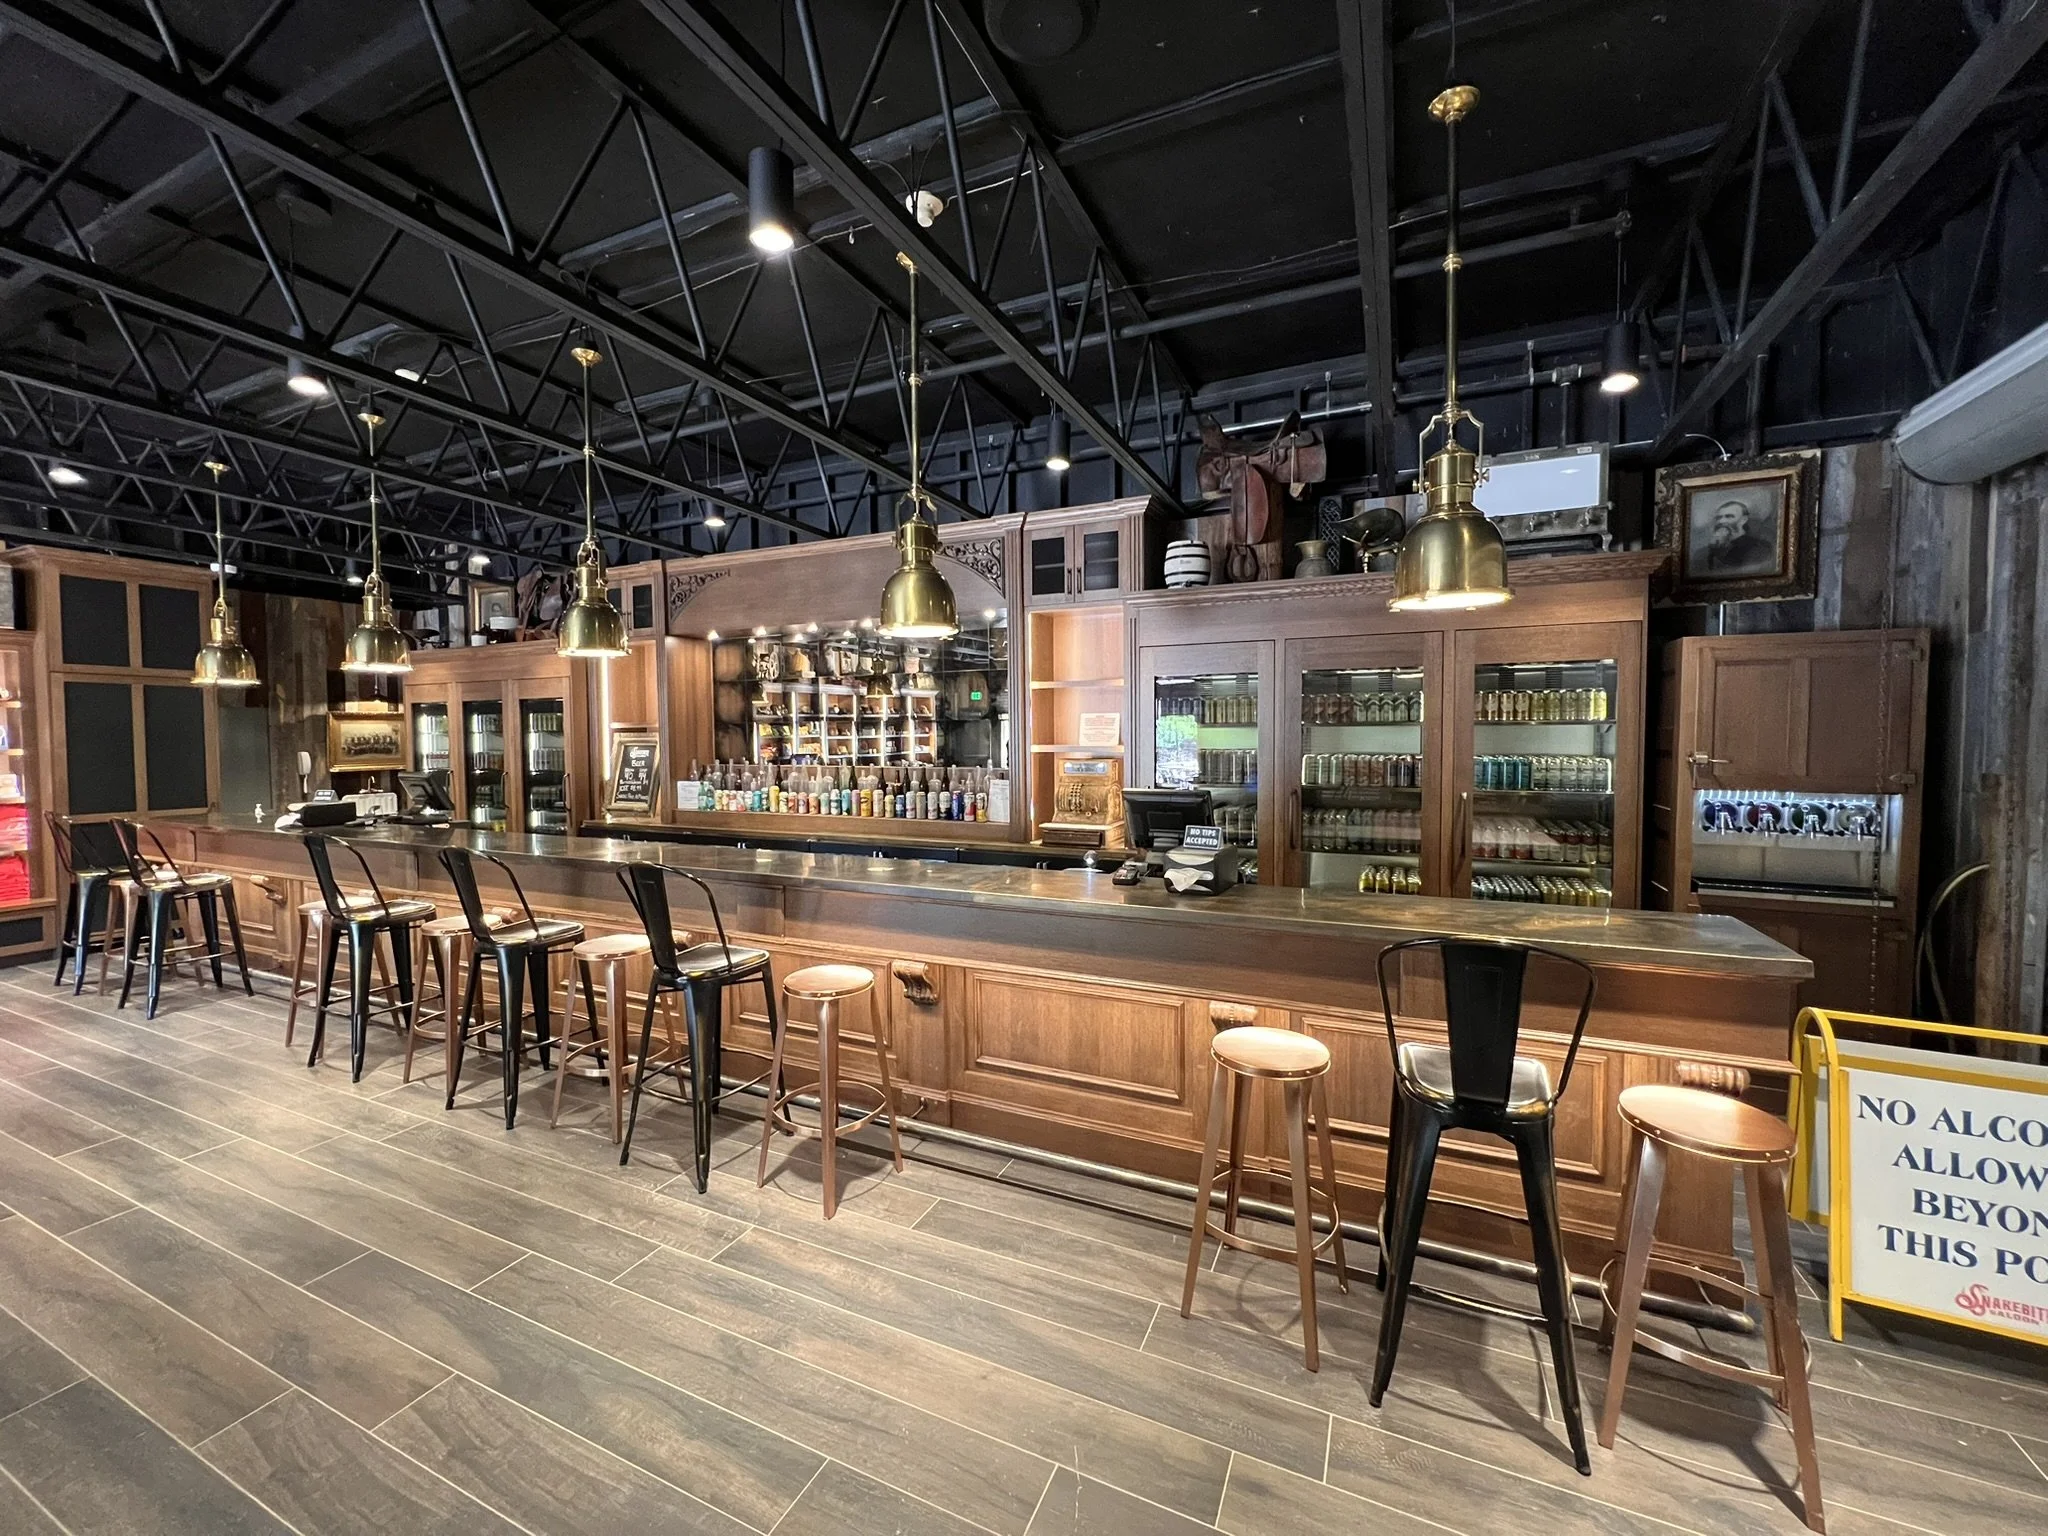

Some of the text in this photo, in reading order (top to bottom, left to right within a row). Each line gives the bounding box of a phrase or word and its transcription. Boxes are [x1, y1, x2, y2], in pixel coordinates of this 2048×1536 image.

[1185, 836, 1218, 845] ACCEPTED
[1857, 1094, 2048, 1148] NO ALCO
[1891, 1143, 2048, 1193] ALLOW
[1877, 1224, 1978, 1268] THIS
[1954, 1283, 2048, 1322] SNAKEBIT
